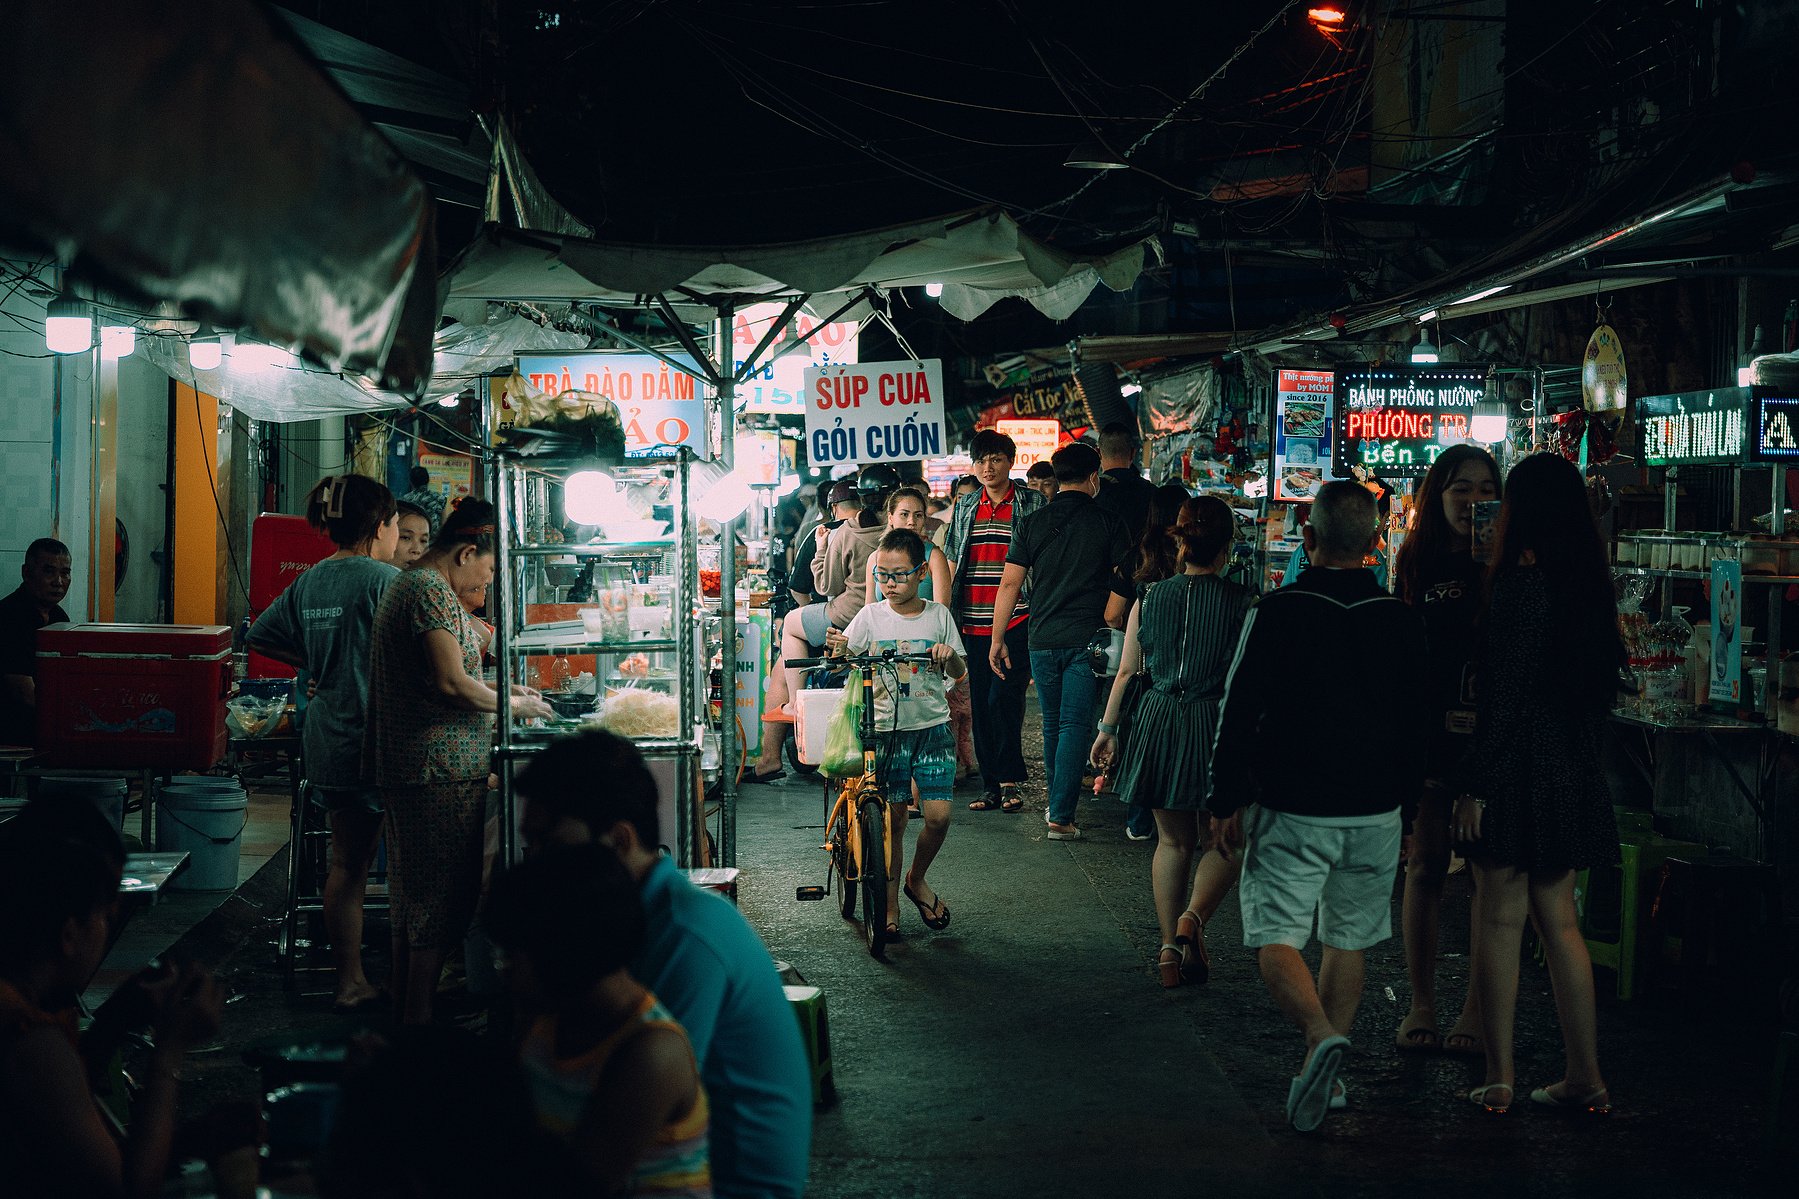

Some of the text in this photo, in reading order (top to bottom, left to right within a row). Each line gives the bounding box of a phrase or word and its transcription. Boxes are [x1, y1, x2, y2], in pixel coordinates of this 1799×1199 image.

[529, 360, 695, 401] TRÀ ĐÀO DẰM
[816, 369, 869, 410] SÚP
[877, 371, 931, 408] CUA
[1062, 380, 1081, 403] Na
[1297, 383, 1306, 392] by
[1349, 384, 1383, 406] BÁNH
[1389, 380, 1434, 406] PHỒNG
[1307, 394, 1327, 402] 2016
[625, 407, 691, 446] ẢO
[812, 411, 940, 463] GỎI CUỐN
[1348, 411, 1433, 438] PHƯƠNG
[1717, 408, 1741, 456] LAN
[1363, 440, 1441, 464] Bến T
[302, 607, 343, 620] TERRIFIED
[736, 661, 754, 672] NH
[736, 698, 754, 708] NH
